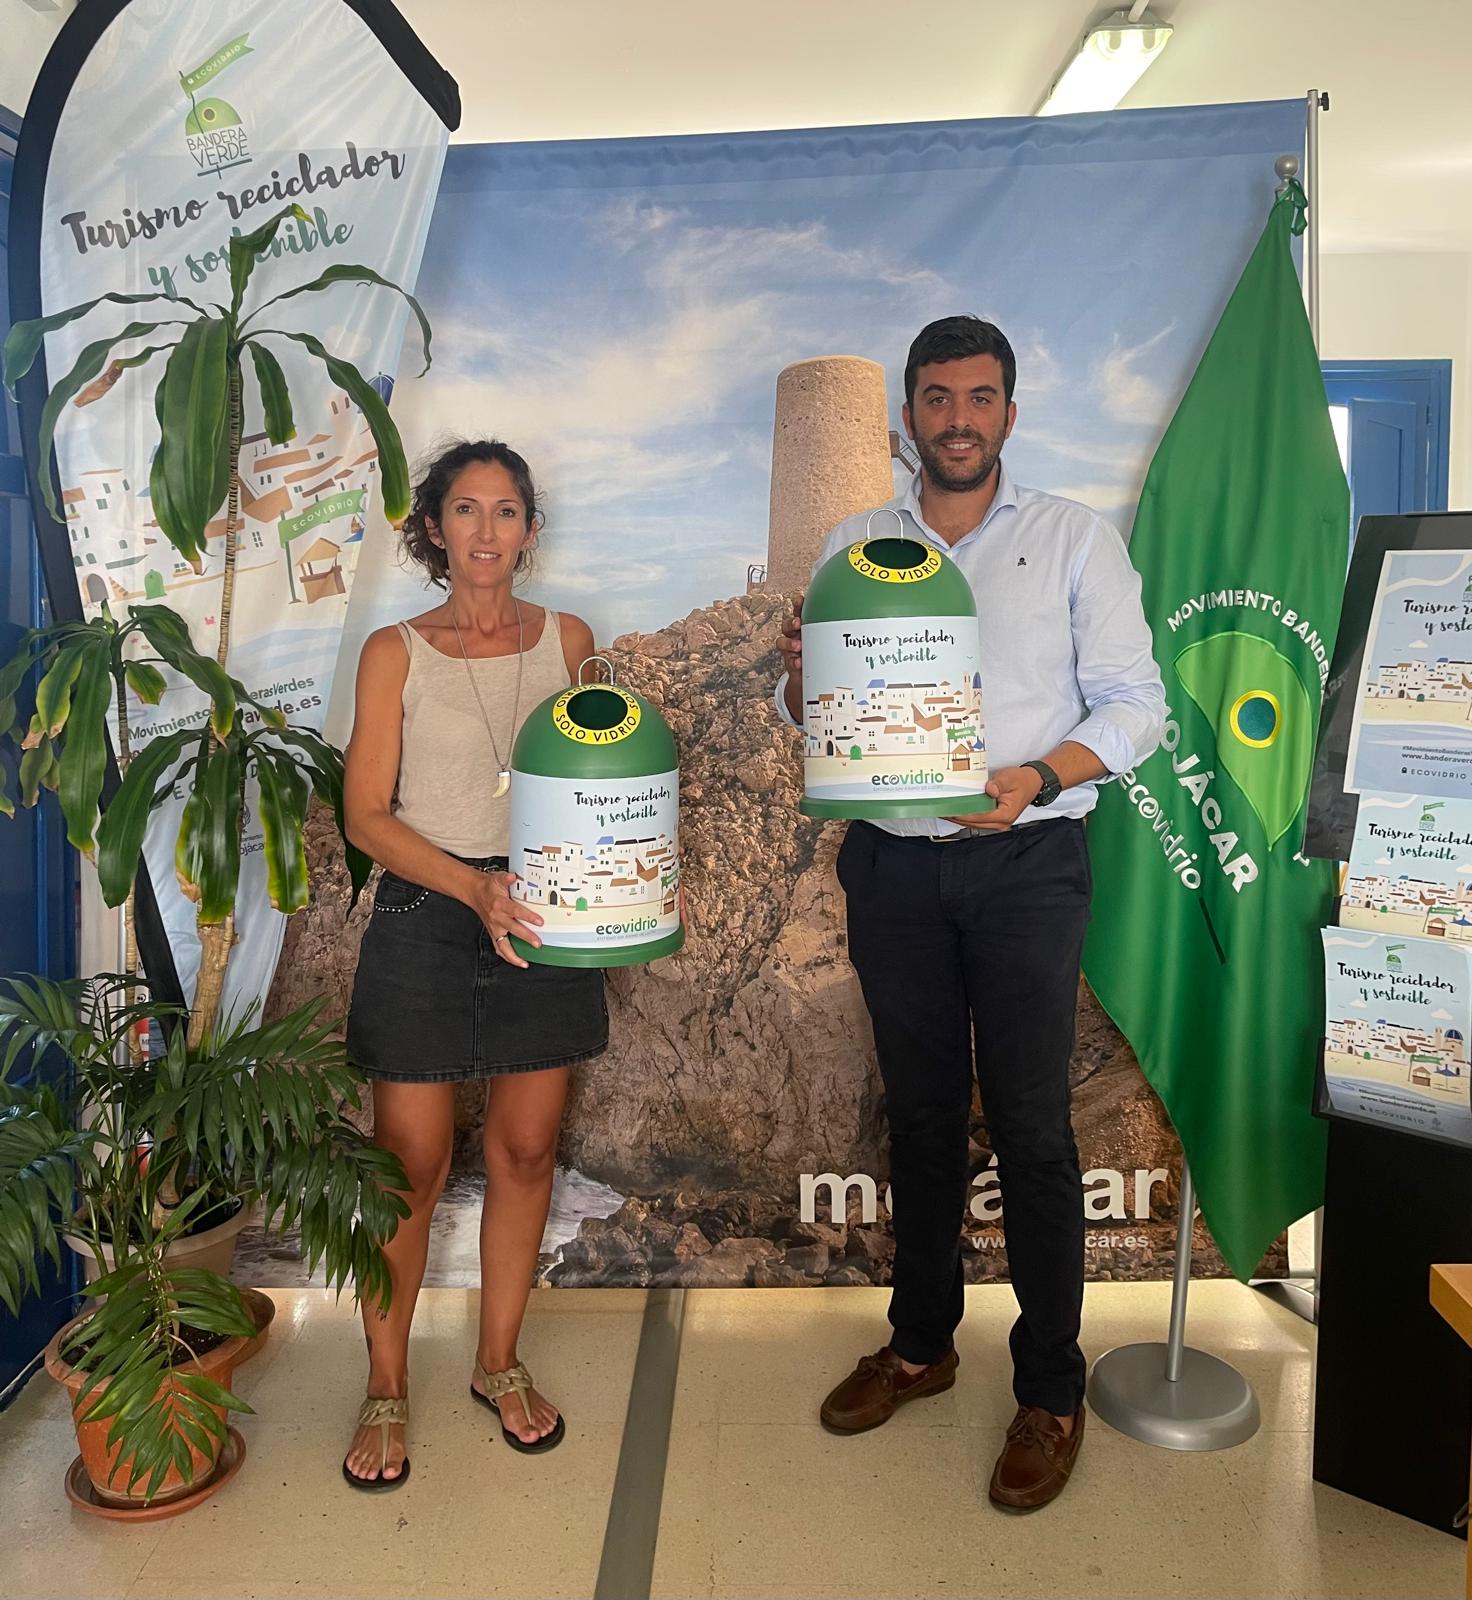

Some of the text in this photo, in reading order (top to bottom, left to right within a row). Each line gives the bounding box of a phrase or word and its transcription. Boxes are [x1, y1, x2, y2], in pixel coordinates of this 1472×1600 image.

[195, 44, 241, 80] ECOVIDRIO
[186, 126, 247, 151] BANDERA
[190, 138, 250, 168] VERDE
[61, 141, 405, 254] Turismo reciclador
[148, 206, 353, 303] y sosnible
[292, 498, 353, 531] ECOVIDRIO
[854, 557, 939, 580] SOLO VIDRIO
[1403, 599, 1460, 614] Turismo
[1425, 622, 1438, 636] y
[842, 633, 893, 649] Turismo
[1167, 589, 1281, 632] MOVIMIENTO
[1280, 609, 1329, 694] BANDE
[865, 656, 875, 670] y
[556, 714, 637, 742] SOLO VIDRIO
[871, 768, 945, 785] ecovidrio
[1410, 768, 1467, 780] ECOVIDRIO
[574, 791, 622, 806] Turismo
[1160, 705, 1258, 893] OJÁCAR
[596, 814, 605, 827] y
[1119, 768, 1201, 890] ecovidrio
[1368, 822, 1416, 839] Turismo
[240, 841, 265, 857] ojáca
[1386, 845, 1395, 859] y
[596, 916, 658, 935] ecovidrio
[1337, 961, 1386, 980] Turismo
[1389, 973, 1457, 994] reciclador
[1360, 986, 1432, 1005] y sostenible
